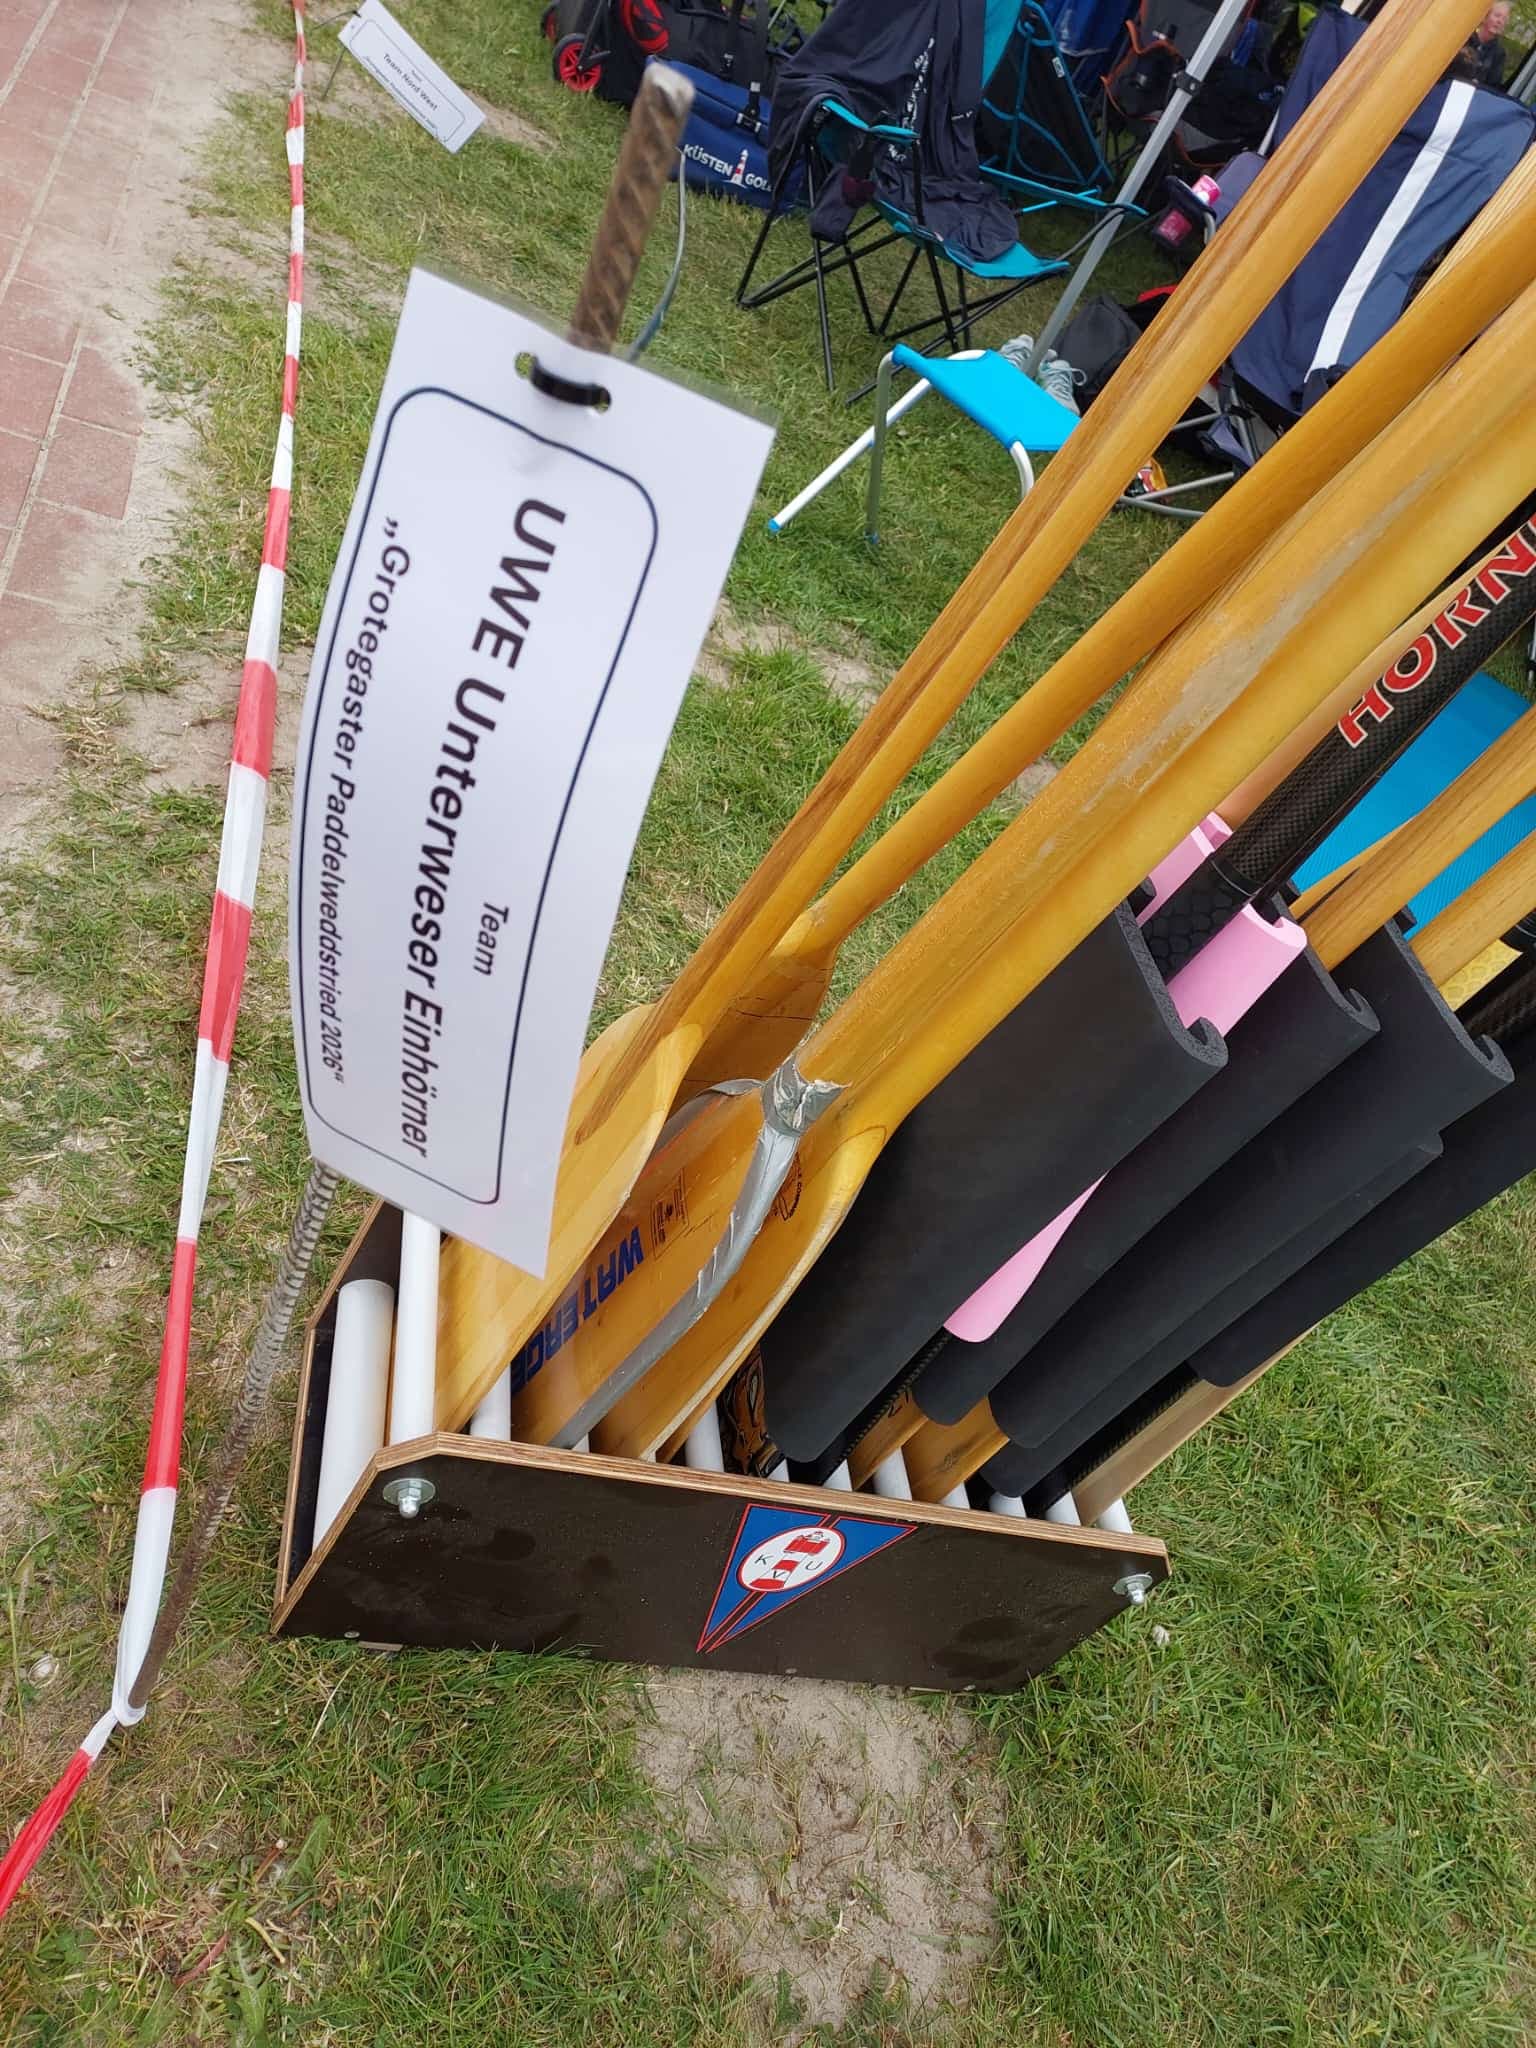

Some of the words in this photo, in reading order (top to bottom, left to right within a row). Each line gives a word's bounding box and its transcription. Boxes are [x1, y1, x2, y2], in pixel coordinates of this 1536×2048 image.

[402, 73, 420, 94] Nord
[420, 90, 438, 111] West
[683, 143, 733, 177] KÜSTEN
[744, 173, 772, 192] GOL
[471, 498, 567, 670] UWE
[1338, 512, 1536, 748] HORN
[318, 772, 356, 1021] Paddelweddstried
[407, 677, 506, 990] Unterweser
[473, 901, 510, 977] Team
[400, 989, 444, 1159] Einhörner
